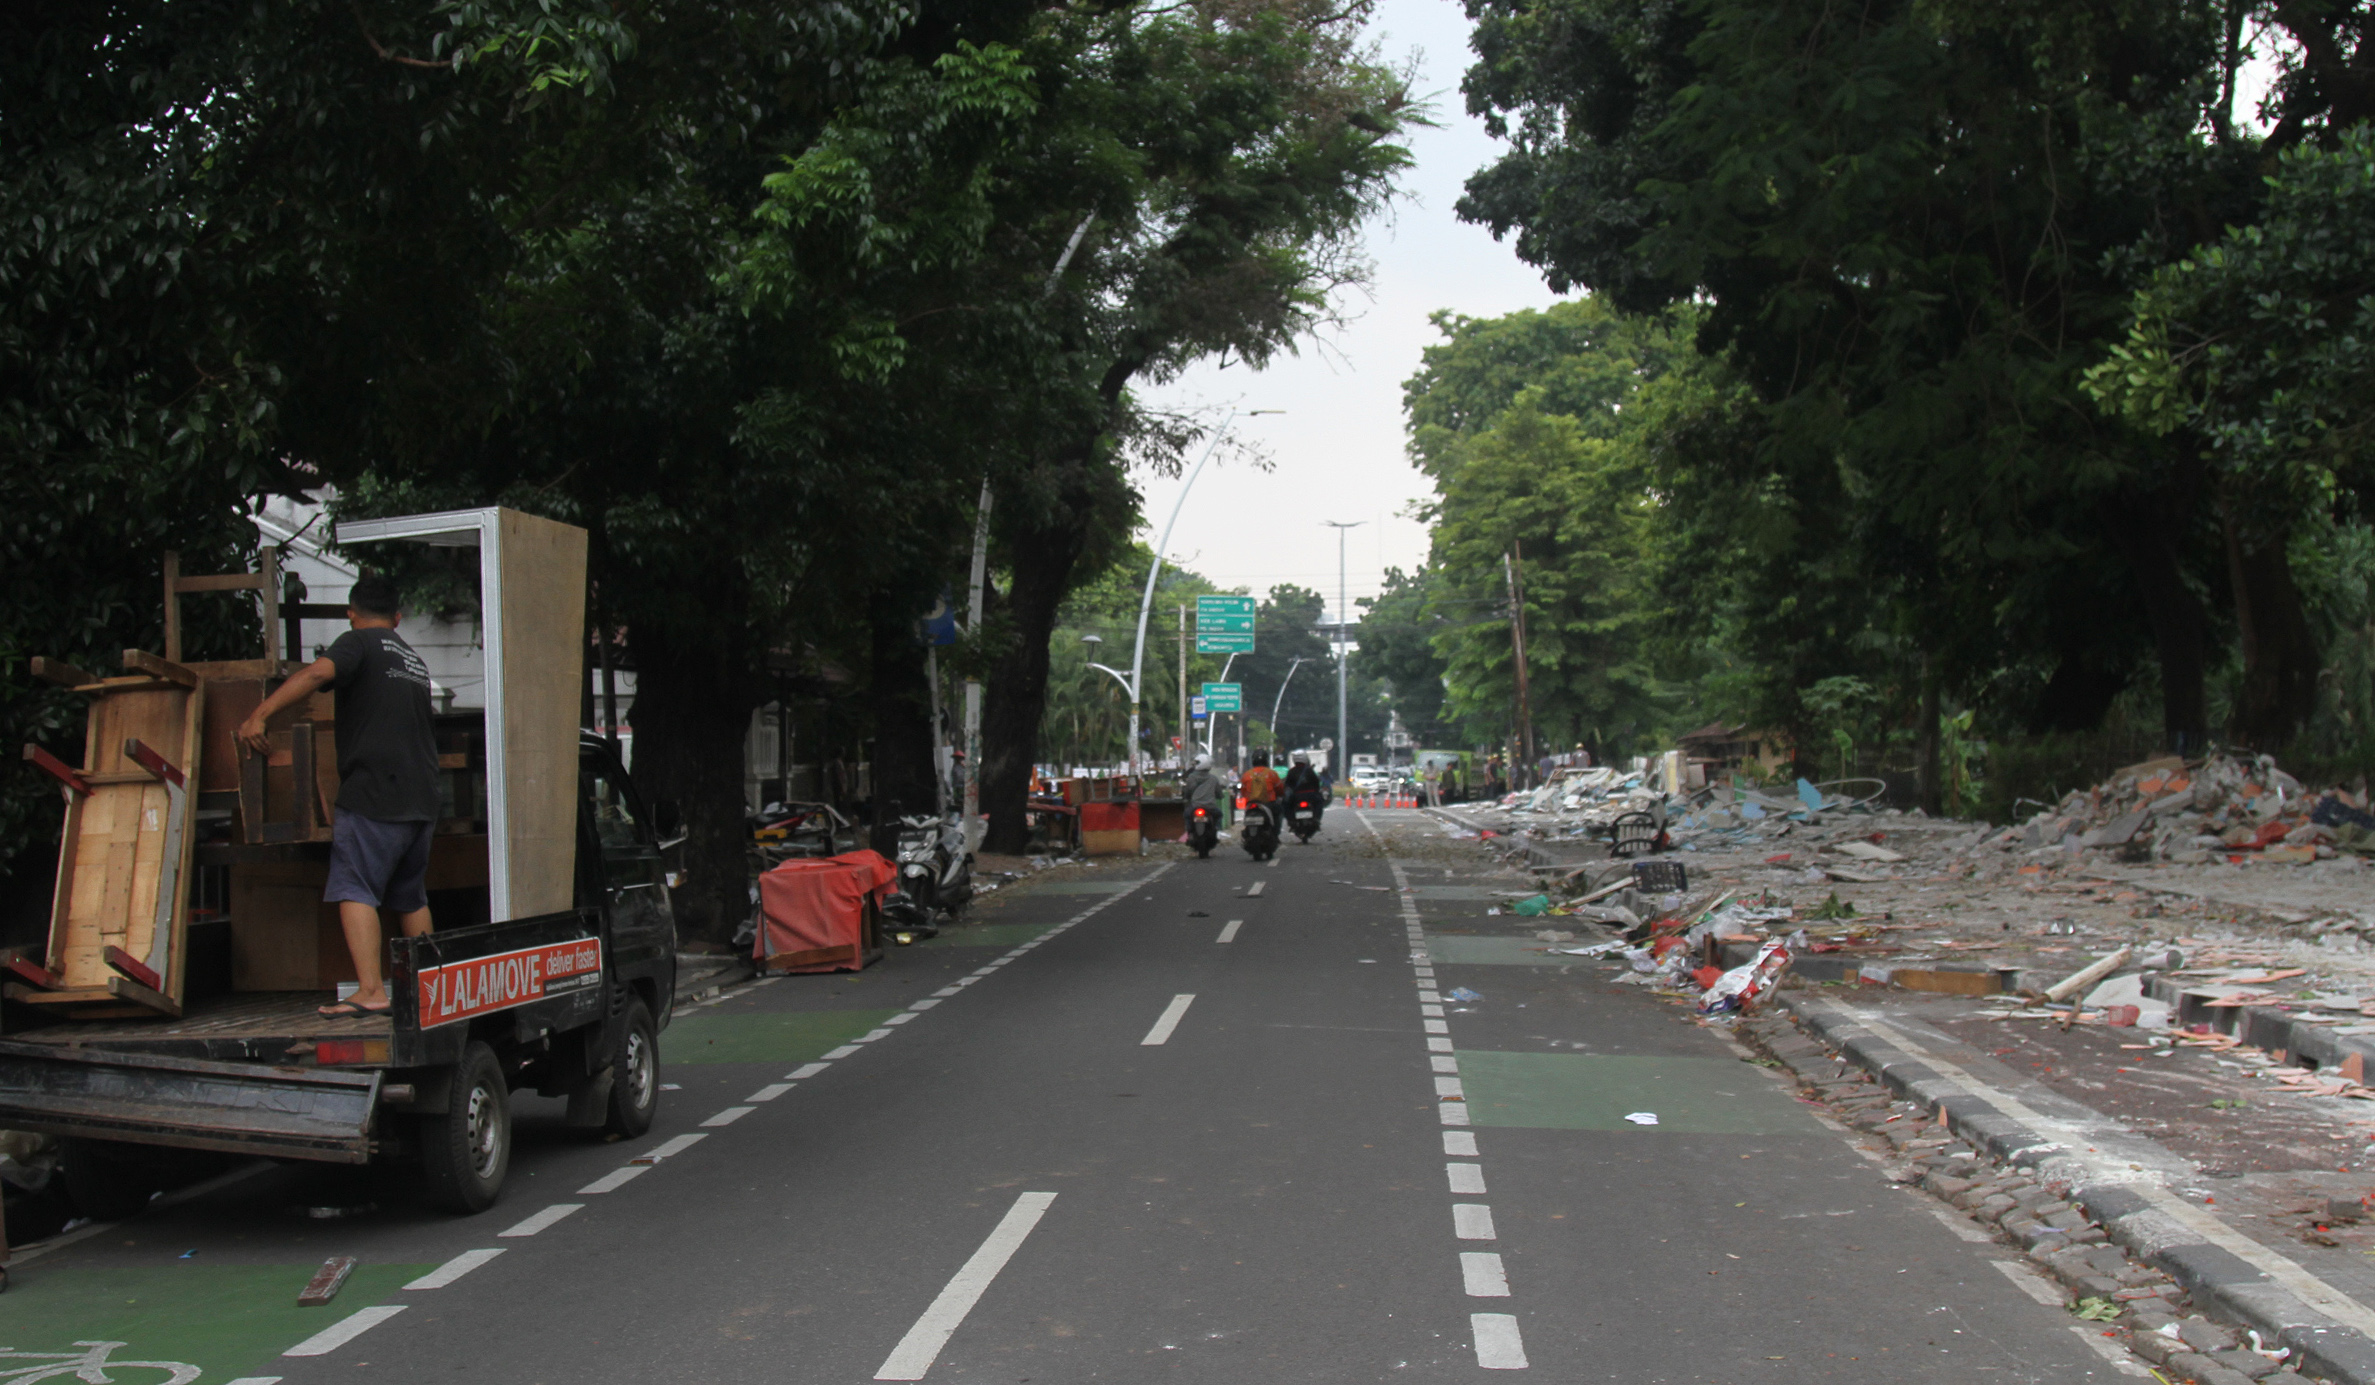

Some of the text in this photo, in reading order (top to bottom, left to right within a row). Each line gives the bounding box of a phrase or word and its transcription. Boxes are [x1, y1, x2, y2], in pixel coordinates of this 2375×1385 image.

[441, 954, 540, 1016] LALAMOVE
[547, 951, 574, 975] deliver
[576, 947, 597, 970] faster
